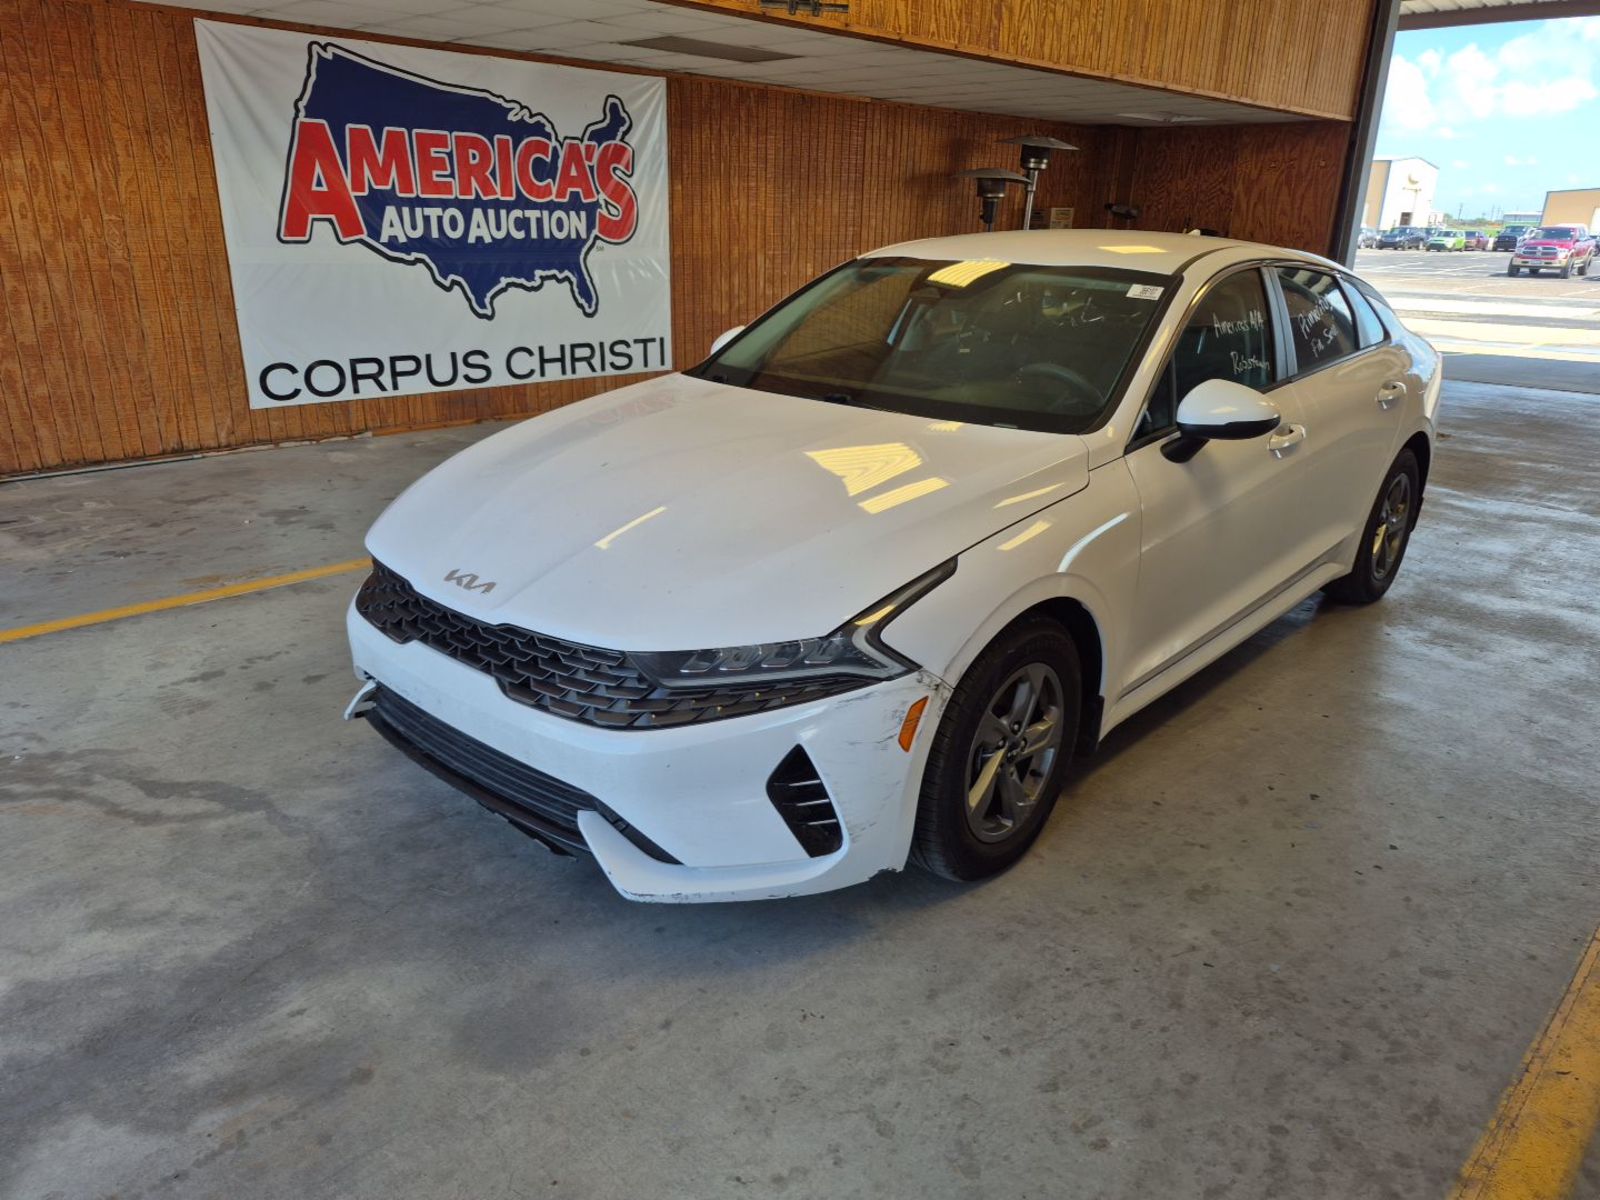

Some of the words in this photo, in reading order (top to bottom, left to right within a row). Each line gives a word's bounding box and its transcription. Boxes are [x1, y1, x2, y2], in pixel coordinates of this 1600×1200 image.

[279, 118, 638, 244] AMERICA'S
[380, 205, 465, 243] AUTO
[467, 207, 587, 243] AUCTION
[258, 349, 493, 402] CORPUS
[505, 336, 667, 380] CHRISTI
